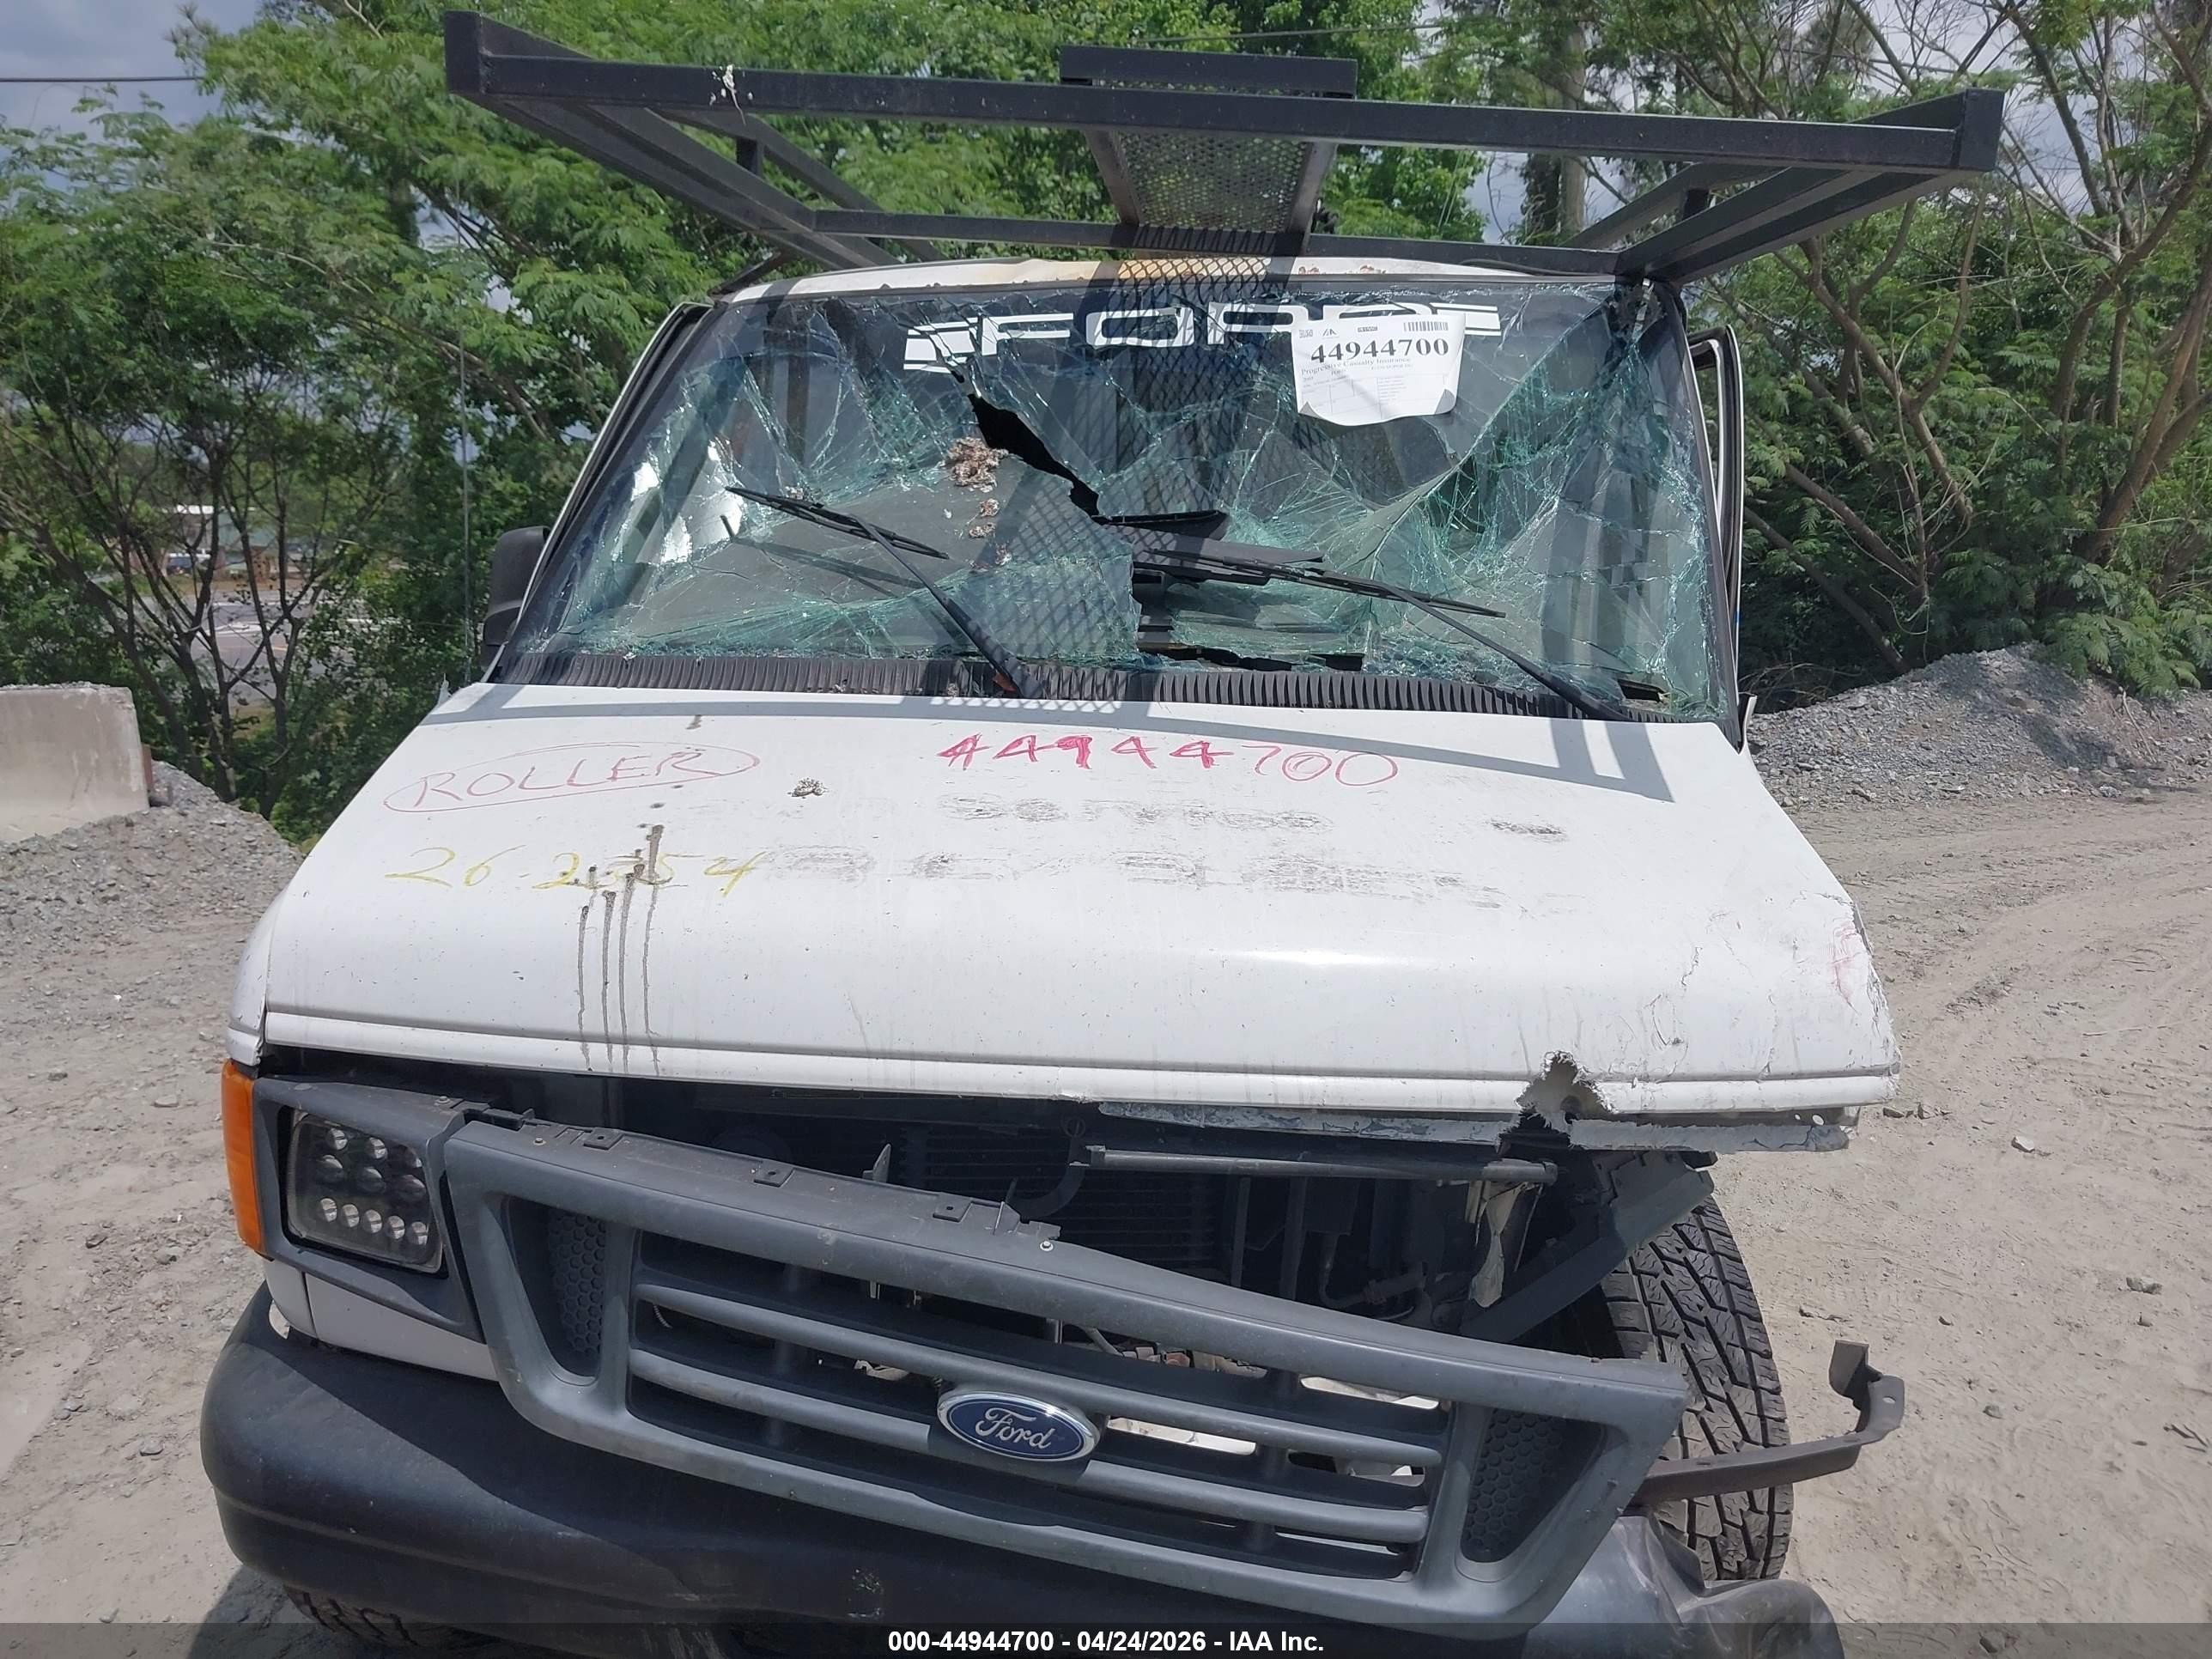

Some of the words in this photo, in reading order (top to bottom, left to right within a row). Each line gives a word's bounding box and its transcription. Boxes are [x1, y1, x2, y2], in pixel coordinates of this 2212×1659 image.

[1310, 337, 1449, 364] 44944700
[414, 750, 723, 808] ROLLER
[936, 734, 1399, 786] 44944700
[975, 1407, 1056, 1449] Ford
